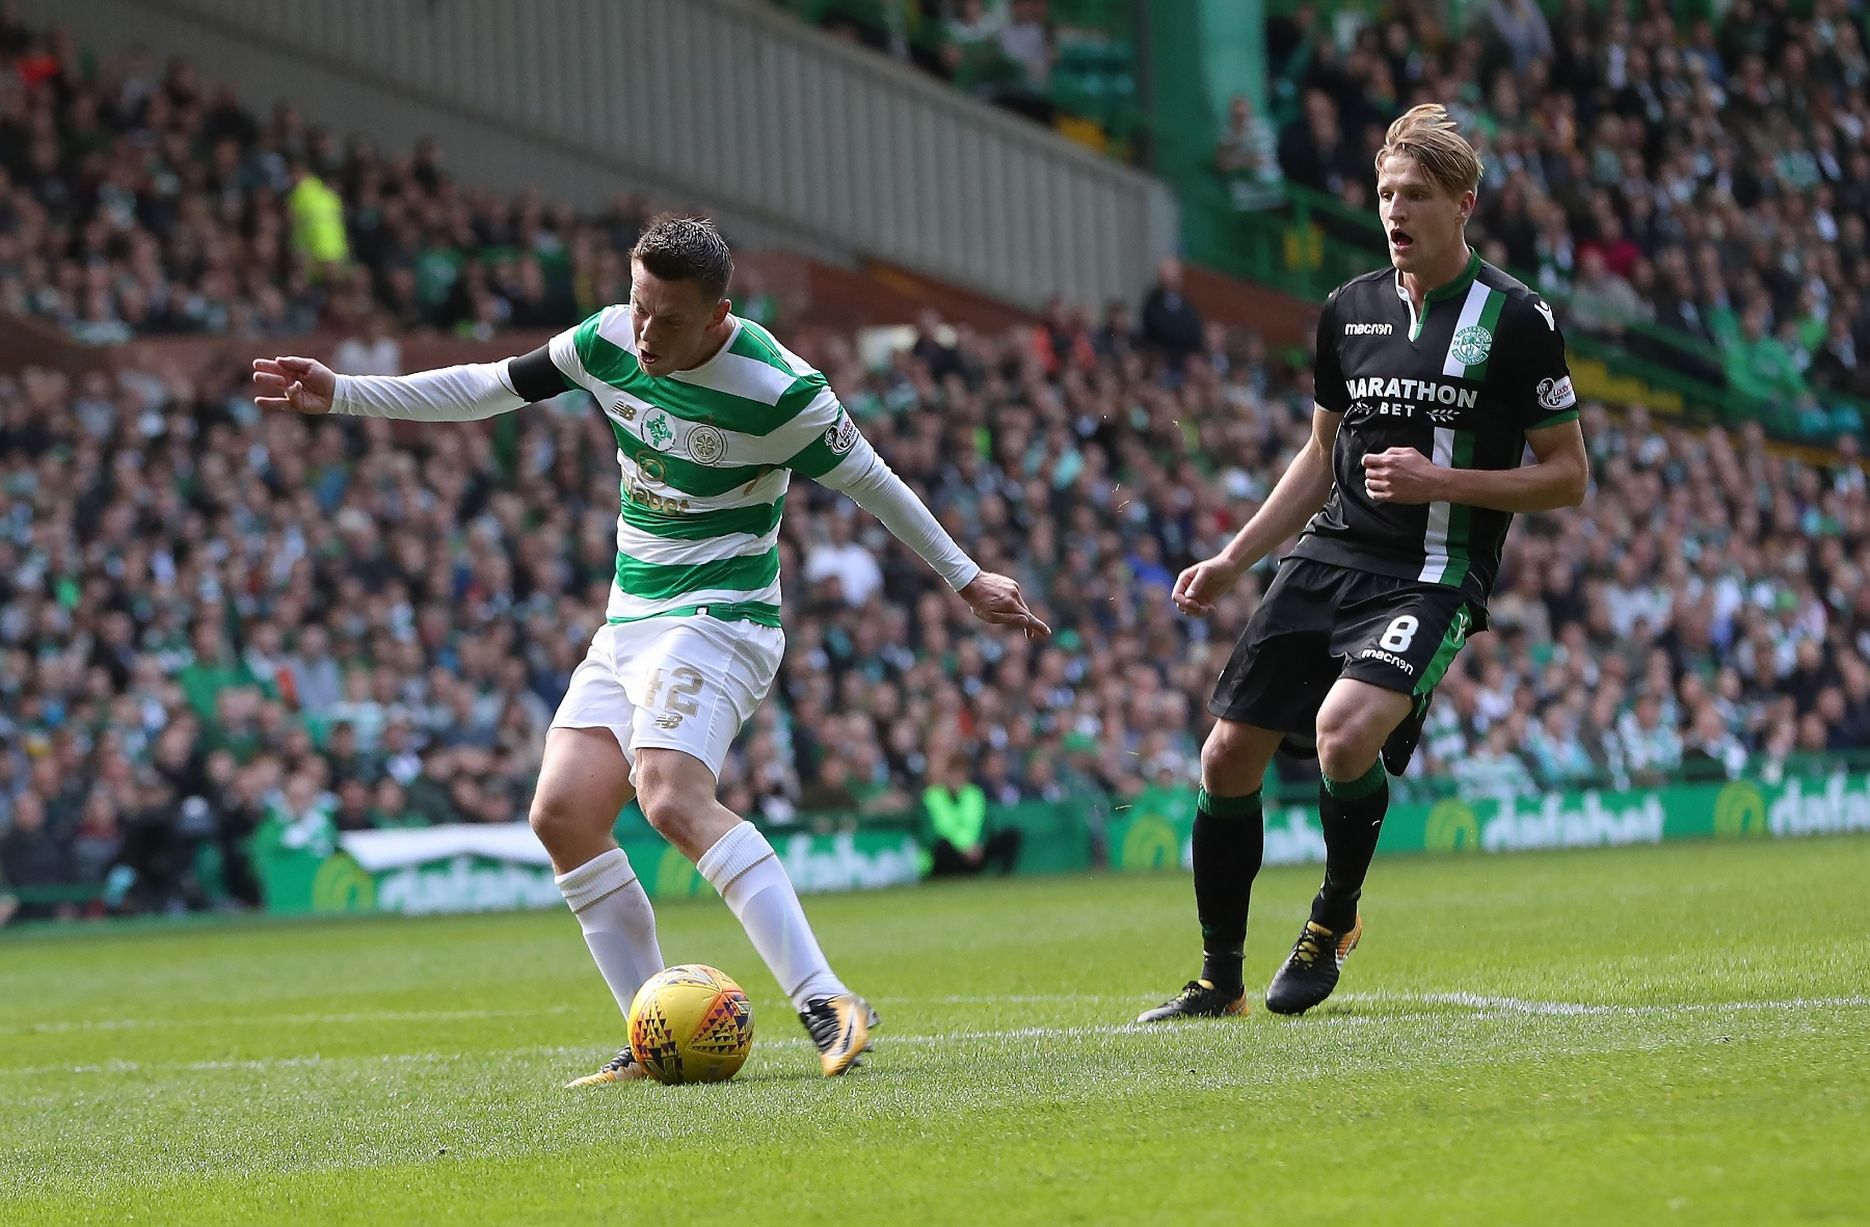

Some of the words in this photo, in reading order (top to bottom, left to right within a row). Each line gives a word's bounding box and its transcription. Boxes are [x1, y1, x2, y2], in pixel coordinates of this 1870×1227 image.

[1345, 323, 1393, 336] macron
[1345, 377, 1478, 409] MARATHON
[1379, 402, 1416, 418] BET
[1378, 614, 1419, 653] 8
[1361, 648, 1415, 676] macron
